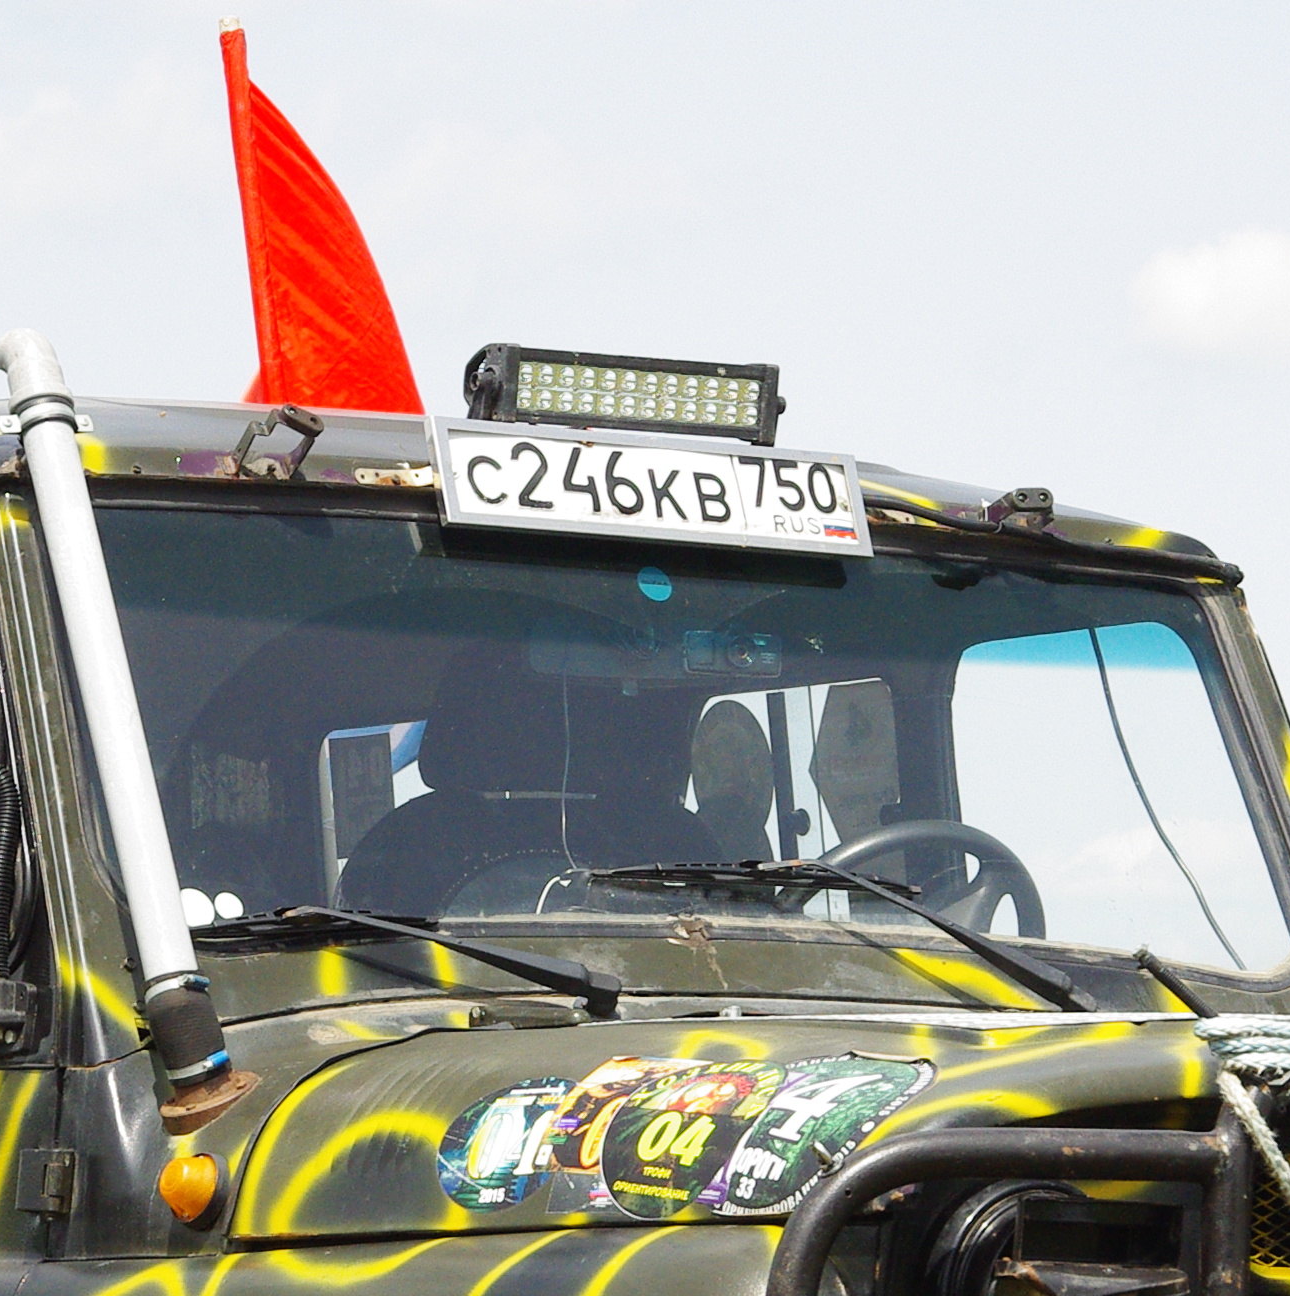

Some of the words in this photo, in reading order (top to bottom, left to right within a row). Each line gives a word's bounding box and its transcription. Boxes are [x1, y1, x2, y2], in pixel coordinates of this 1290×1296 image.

[739, 456, 838, 514] 750
[774, 515, 821, 535] RUS
[637, 1110, 716, 1166] 04
[642, 1166, 672, 1179] ТРОФИ
[478, 1187, 506, 1203] 2015
[613, 1180, 691, 1201] ОРИЕНТИРОВАНИЕ
